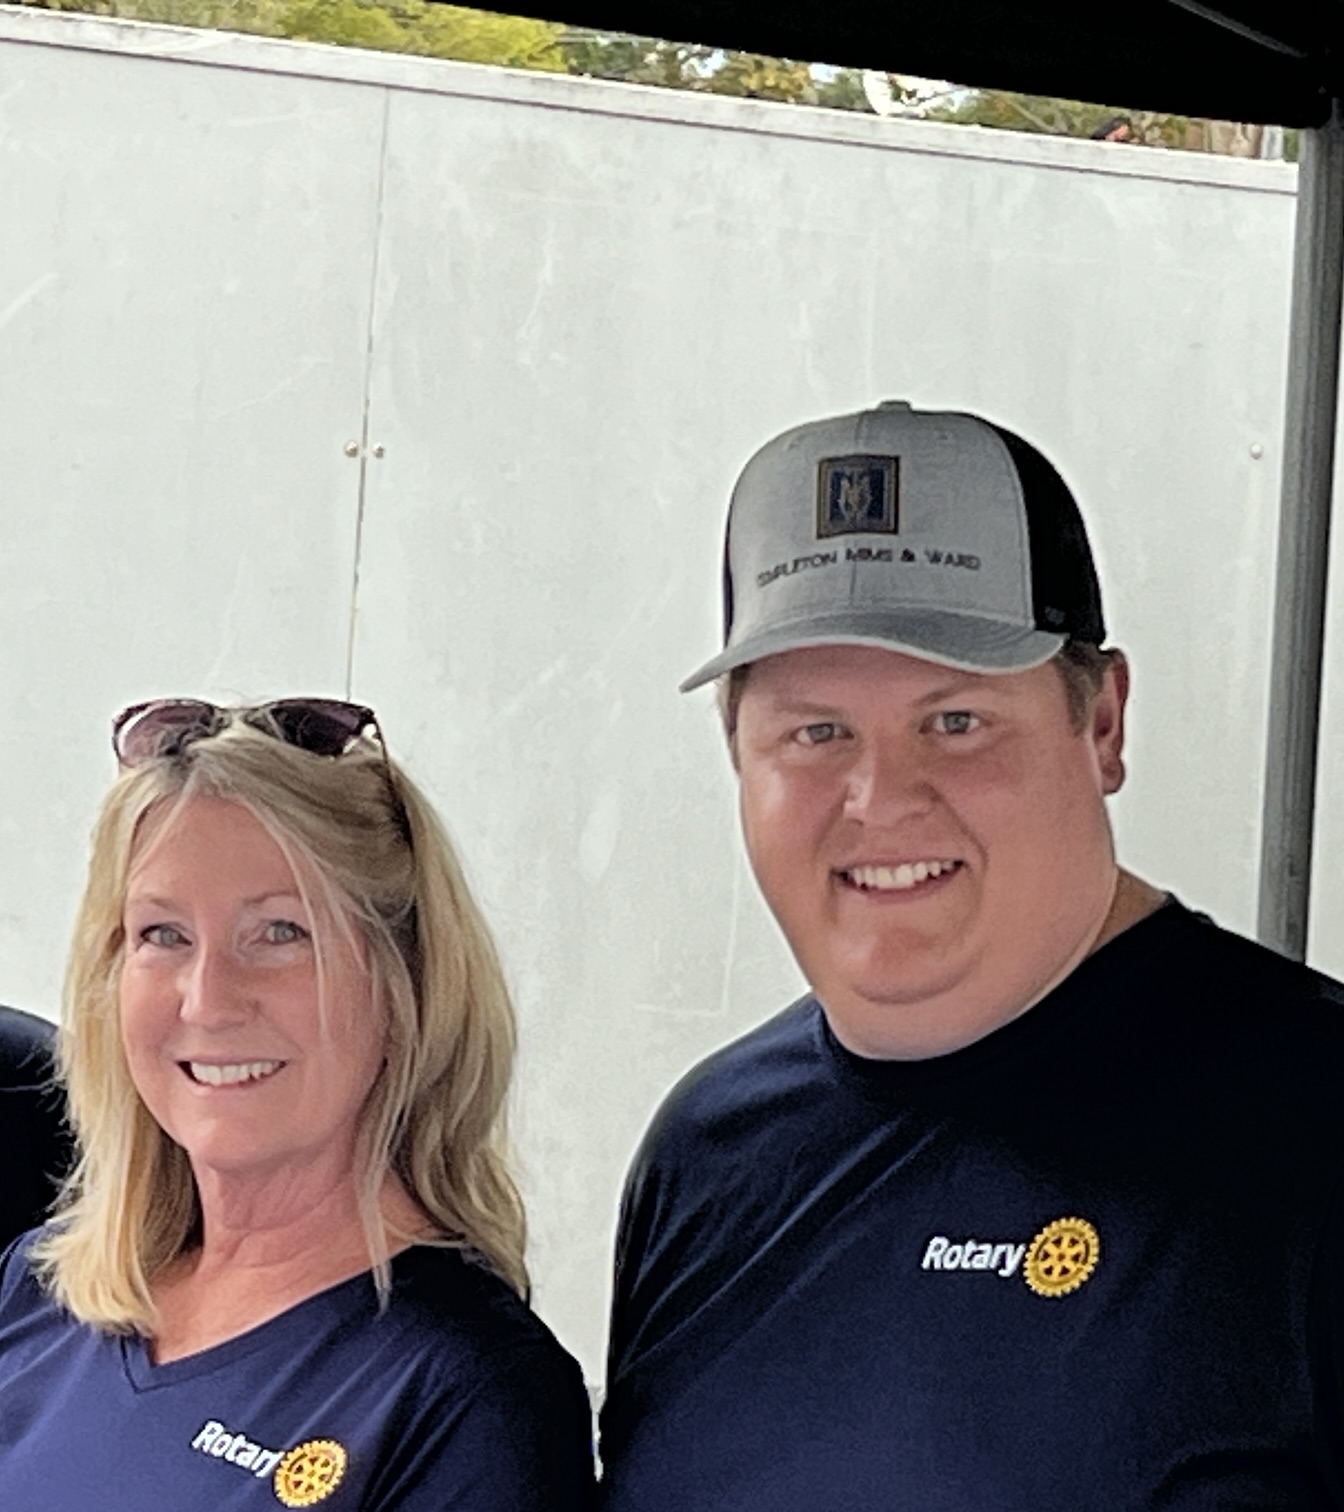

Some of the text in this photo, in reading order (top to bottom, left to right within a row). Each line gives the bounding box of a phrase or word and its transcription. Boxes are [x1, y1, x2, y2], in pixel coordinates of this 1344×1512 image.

[900, 548, 916, 563] &
[925, 549, 981, 571] WARD
[921, 1236, 1026, 1277] Rotary
[190, 1420, 285, 1478] Rotary
